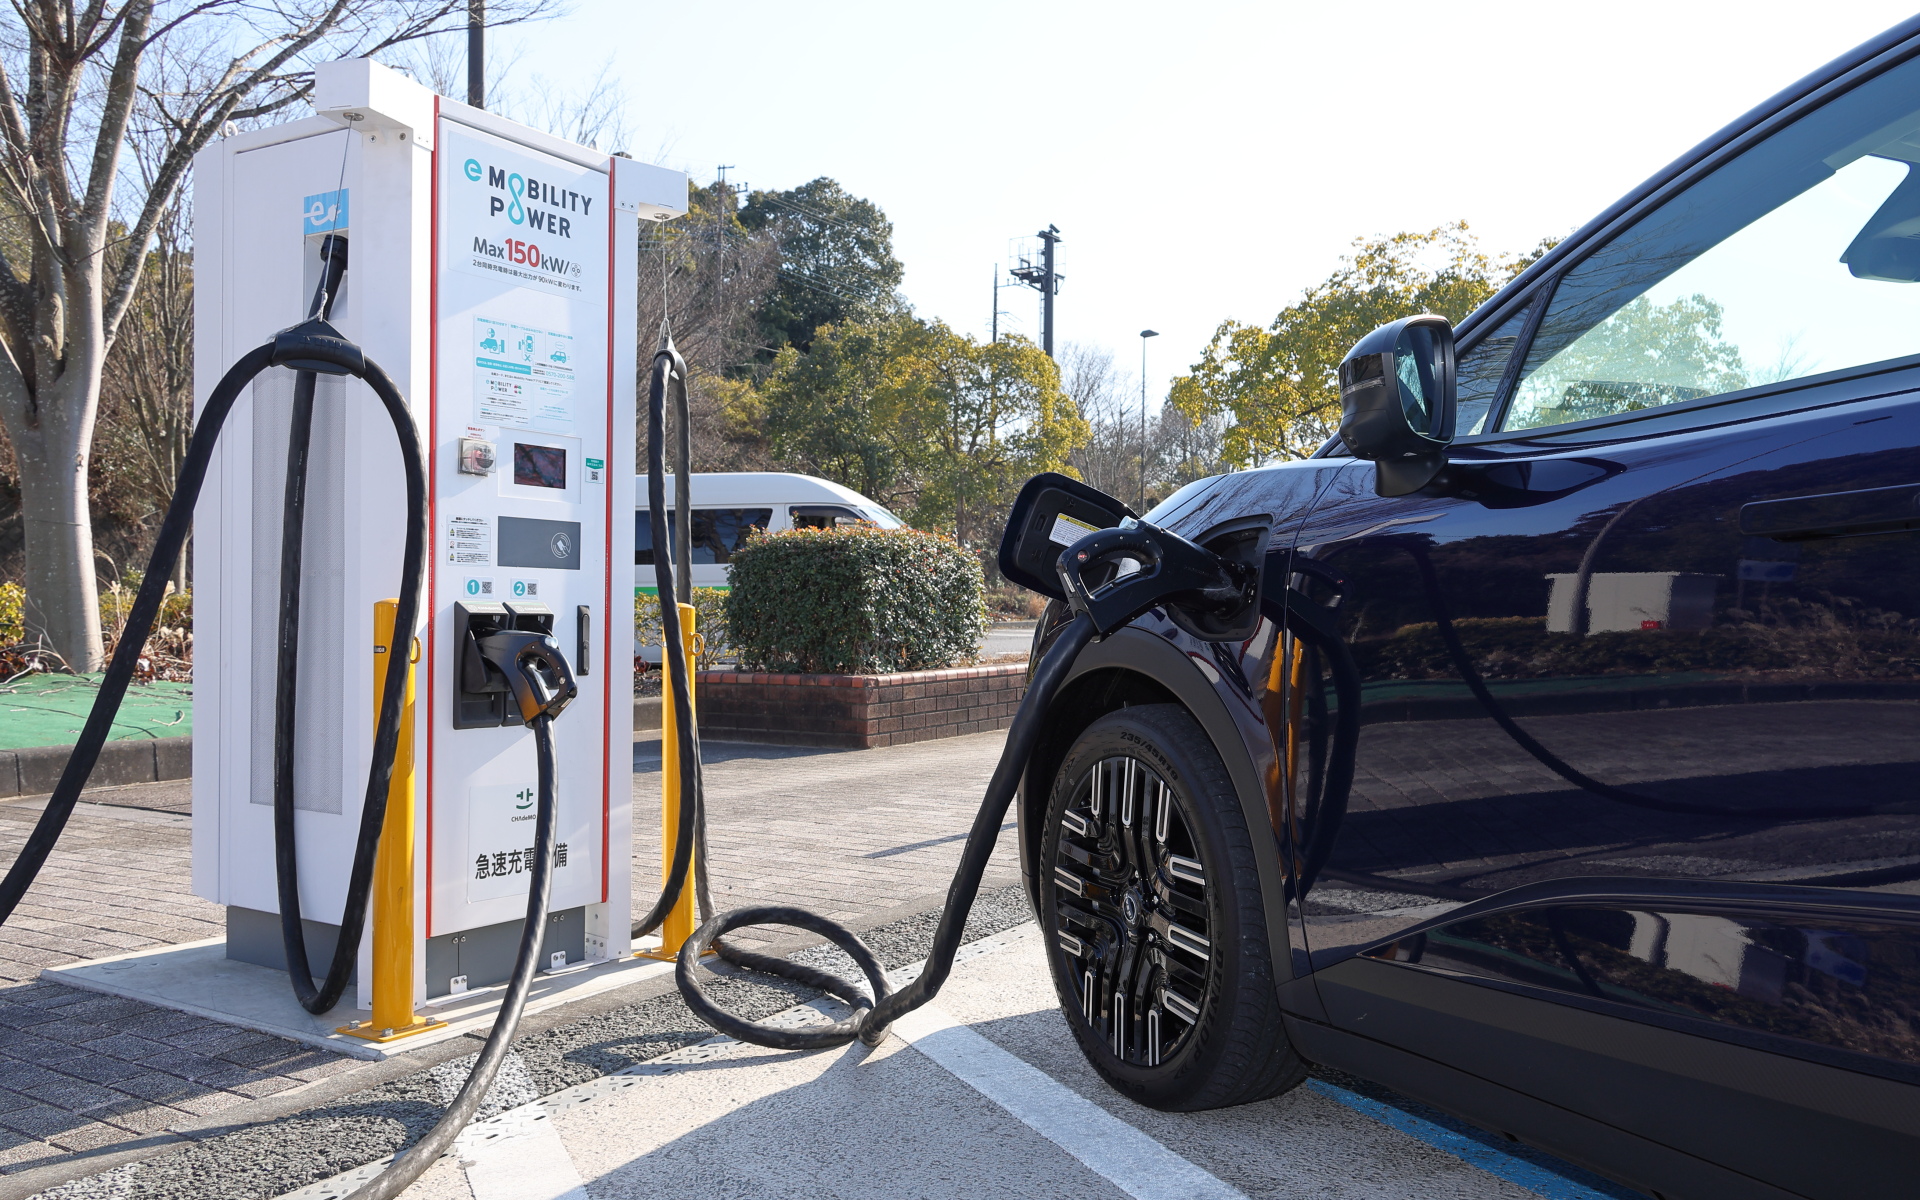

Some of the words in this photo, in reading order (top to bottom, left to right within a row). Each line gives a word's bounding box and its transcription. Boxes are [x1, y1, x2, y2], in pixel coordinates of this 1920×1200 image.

[464, 158, 482, 182] e
[489, 165, 593, 216] MOBILITY
[490, 196, 571, 239] POWER
[1120, 730, 1179, 781] 235/45R19
[475, 842, 568, 880] 急速充電備
[1194, 944, 1224, 1064] DUNLOP
